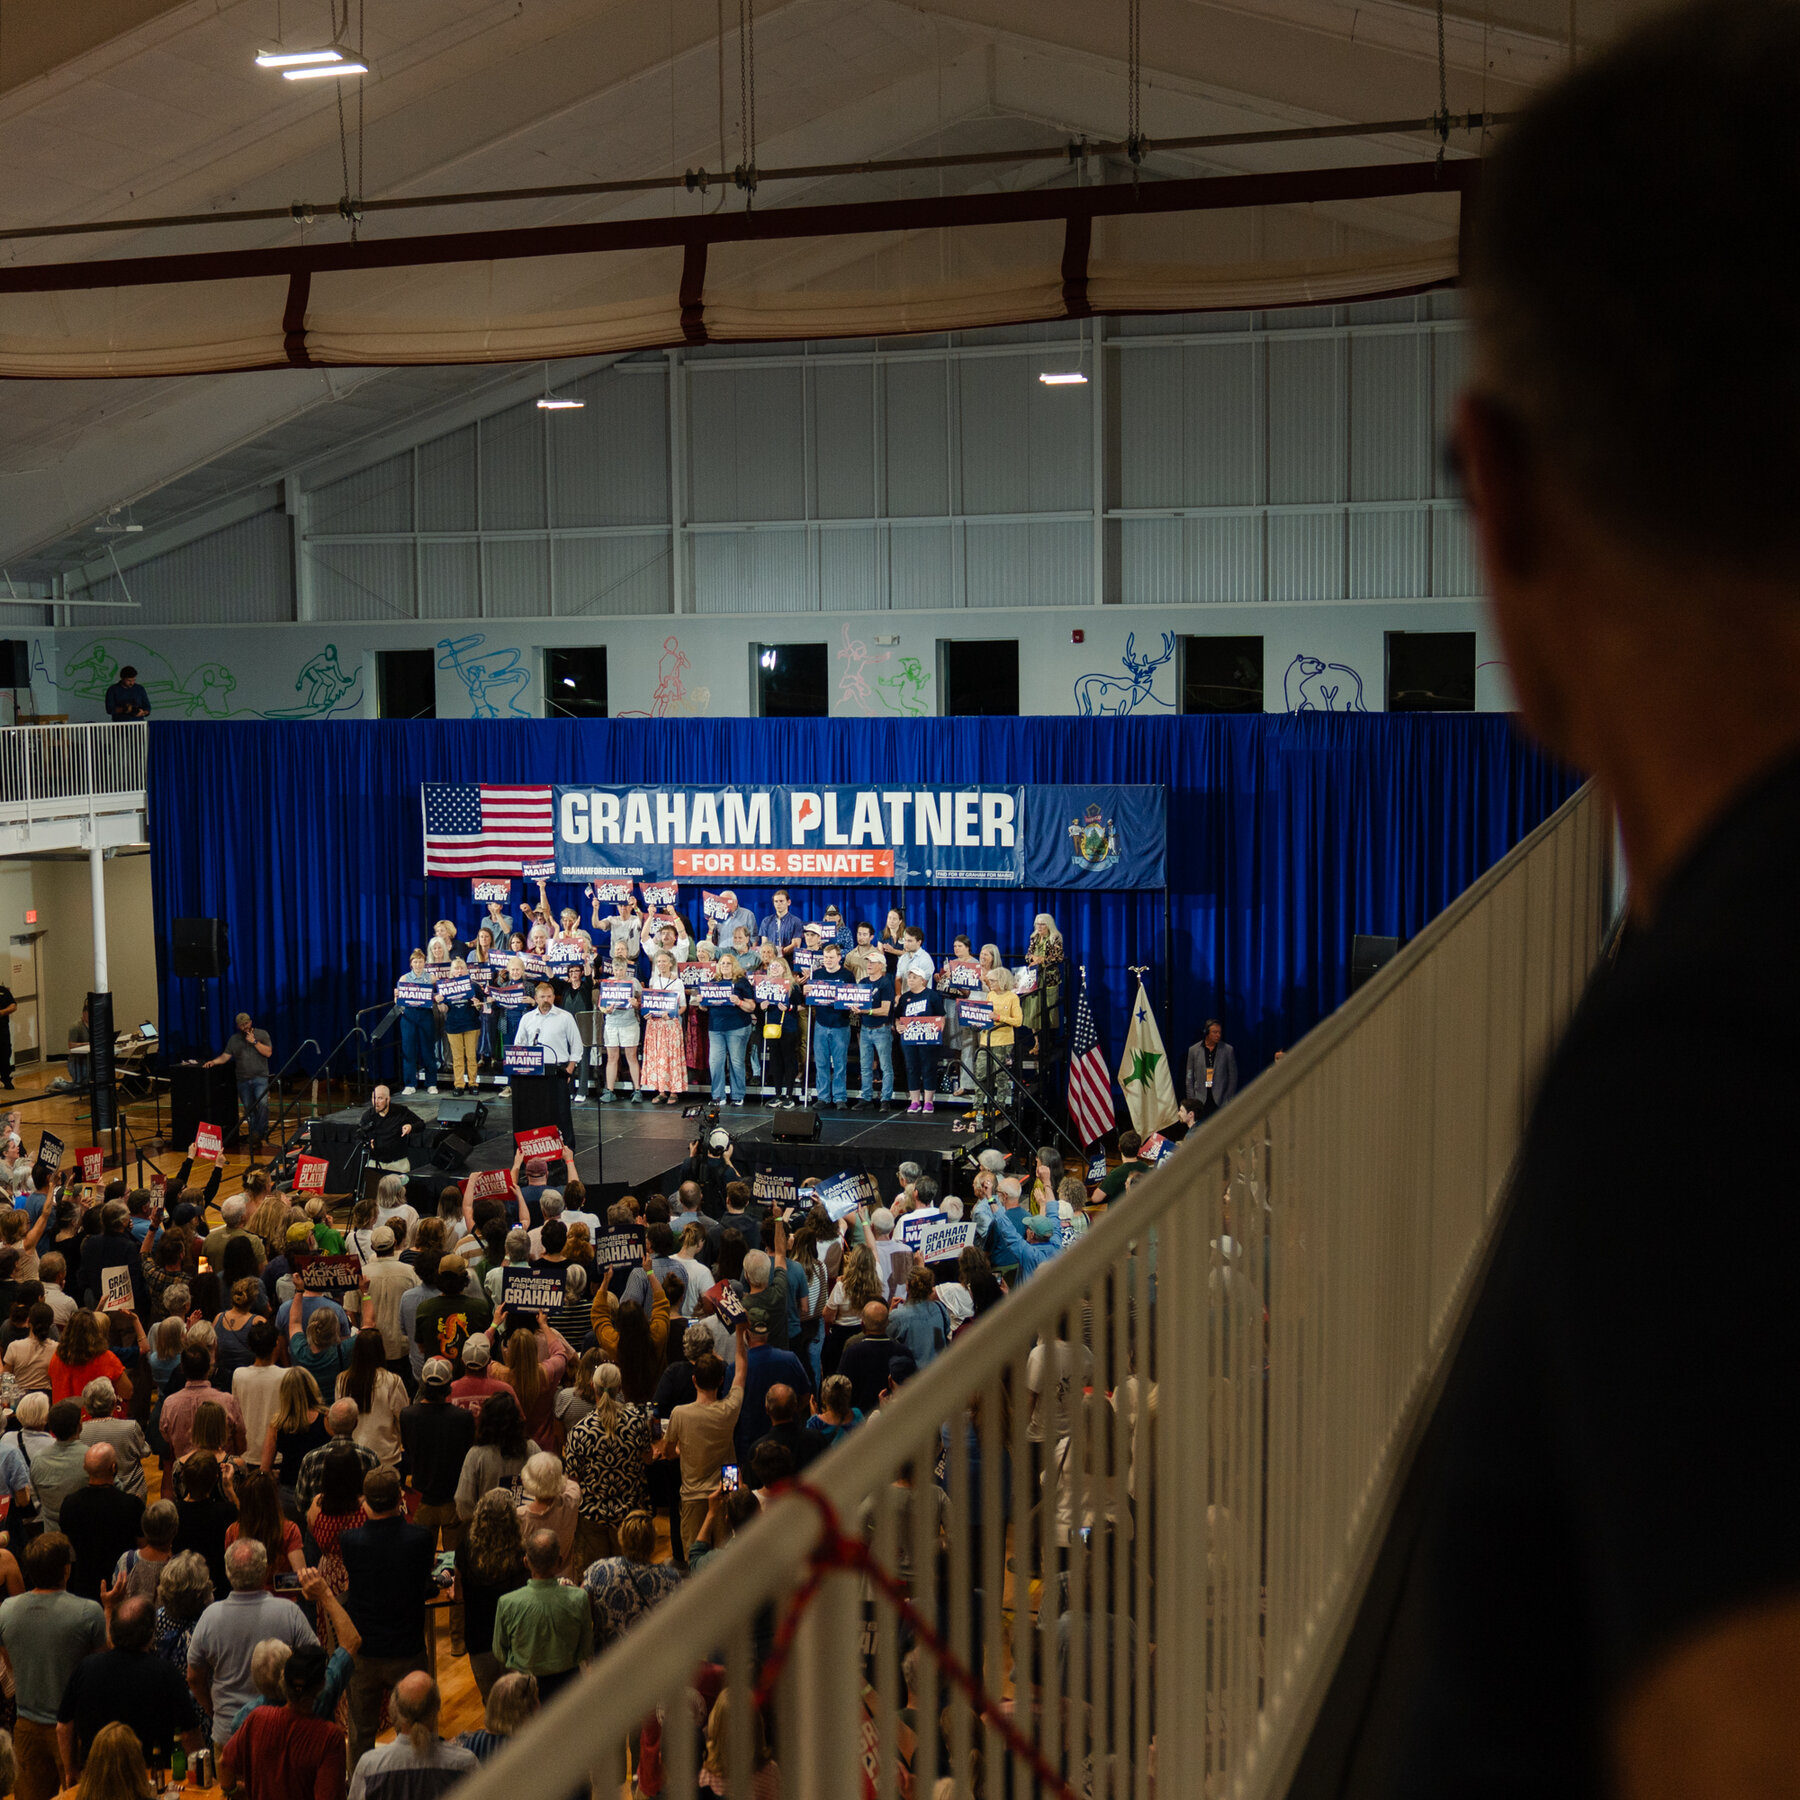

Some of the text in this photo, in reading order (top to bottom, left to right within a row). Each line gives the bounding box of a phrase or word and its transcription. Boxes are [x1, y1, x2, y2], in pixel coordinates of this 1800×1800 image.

[560, 790, 1015, 848] GRAHAM PLATNER
[691, 853, 874, 873] FOR U.S. SENATE
[524, 866, 556, 877] MAINE
[562, 866, 644, 876] GRAHAMFORSENATE.COM
[439, 982, 472, 996] MAINE
[700, 990, 732, 998] MAINE
[808, 989, 836, 998] MAIN
[399, 990, 432, 1000] MAINE
[601, 991, 631, 1000] MAINE
[837, 992, 870, 1002] MAINE
[643, 1000, 676, 1011] MAINE
[505, 1056, 543, 1066] MAINE
[197, 1135, 221, 1152] GRAHAM
[520, 1135, 553, 1146] EDUCATORS
[521, 1138, 563, 1157] GRAHAM
[40, 1147, 58, 1166] GRA
[1088, 1167, 1107, 1179] GRA
[773, 1175, 794, 1183] CARE
[474, 1180, 508, 1195] LATNER
[752, 1182, 796, 1201] GRAHAM
[823, 1175, 860, 1197] FARMERS
[926, 1224, 969, 1244] GRAHAM
[925, 1233, 967, 1255] PLATNER
[318, 1261, 352, 1270] Senator
[302, 1267, 356, 1277] MONEY
[303, 1274, 358, 1287] CAN'T BUY
[508, 1276, 554, 1286] FARMERS
[511, 1282, 551, 1291] FISHERS
[504, 1288, 563, 1307] GRAHAM
